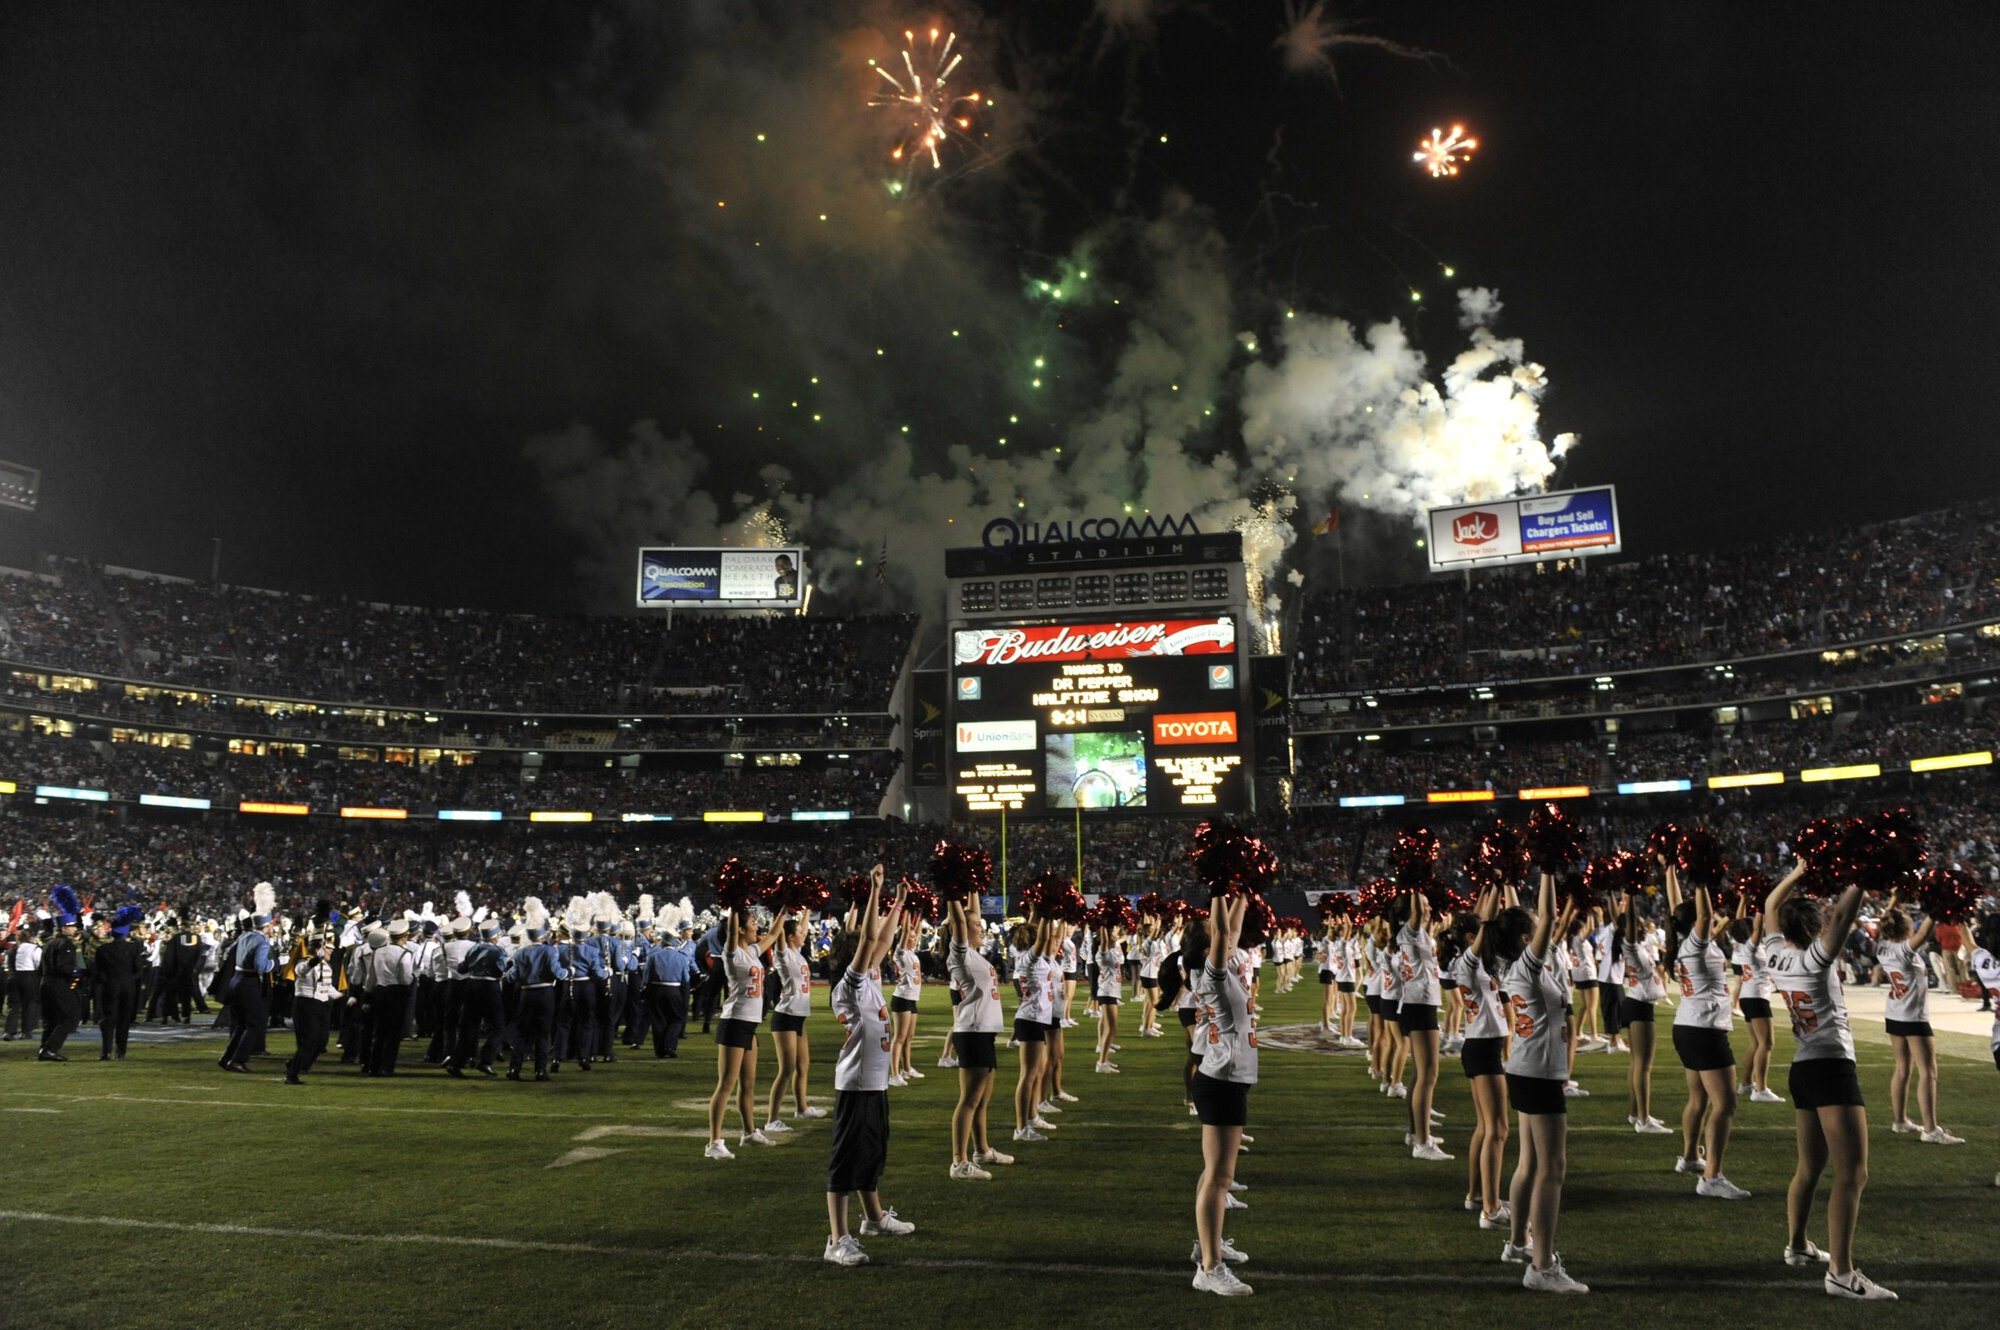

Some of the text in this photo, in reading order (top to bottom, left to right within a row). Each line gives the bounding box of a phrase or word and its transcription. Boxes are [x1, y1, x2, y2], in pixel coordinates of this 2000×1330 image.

[1538, 510, 1594, 527] Buy and Sell
[982, 513, 1200, 553] QUALCOMM
[1455, 515, 1498, 543] Jack
[1527, 521, 1608, 539] Chargers Tickets!
[1028, 544, 1183, 562] STADIUM
[645, 565, 717, 580] QUALCOMM
[724, 564, 773, 572] POMERADO
[724, 573, 773, 581] HEALTH
[979, 623, 1166, 665] Budweiser
[1062, 663, 1123, 675] THANKS TO
[1053, 676, 1132, 690] DR PEPPER
[1033, 689, 1158, 705] HALFTIME SHOW
[913, 727, 943, 740] Sprint
[1157, 721, 1233, 737] TOYOTA
